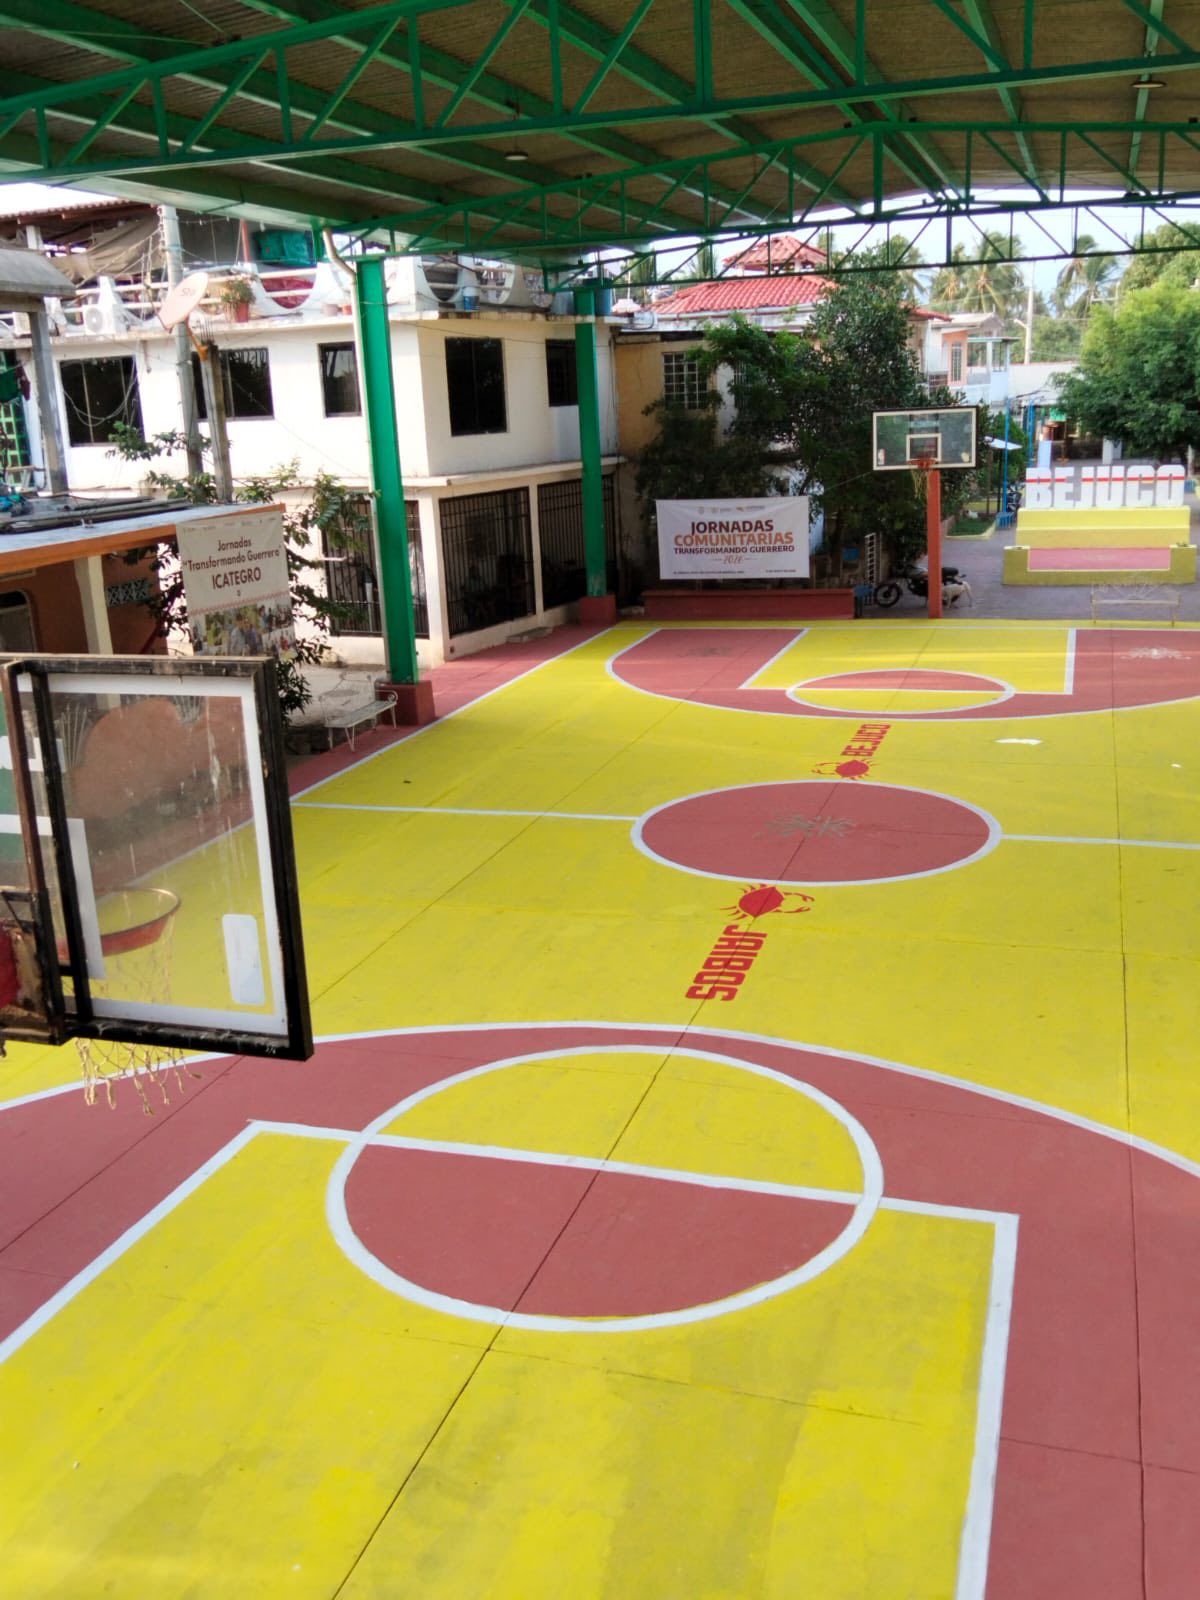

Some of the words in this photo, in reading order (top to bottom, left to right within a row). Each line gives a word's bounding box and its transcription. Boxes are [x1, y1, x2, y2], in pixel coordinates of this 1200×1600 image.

[1025, 464, 1186, 509] BEJUCO
[690, 519, 774, 535] JORNADAS
[218, 537, 252, 551] Jornadas
[673, 532, 794, 547] COMUNITARIAS
[673, 547, 748, 555] TRANSFORMANDO
[749, 545, 795, 553] GUERRERO
[212, 567, 262, 589] ICATEGRO
[840, 724, 891, 756] BEJUCO
[685, 924, 768, 1002] JAIBOS
